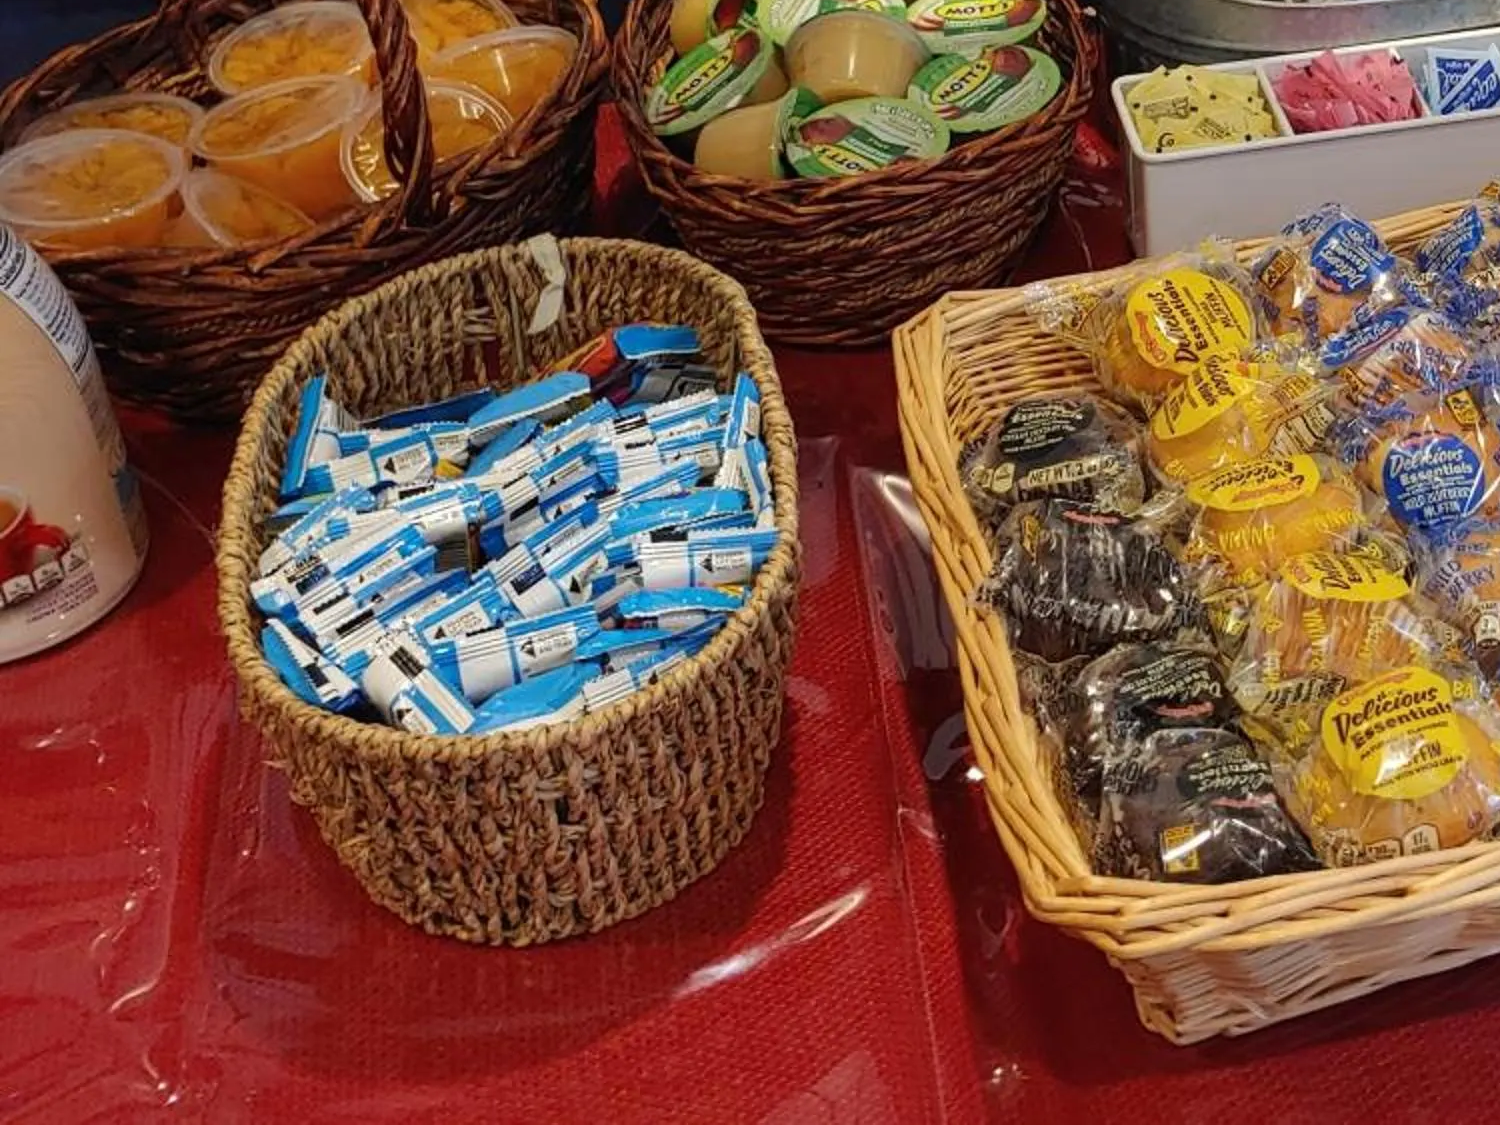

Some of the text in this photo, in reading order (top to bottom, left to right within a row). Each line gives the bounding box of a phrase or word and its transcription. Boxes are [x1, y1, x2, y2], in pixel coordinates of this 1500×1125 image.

[938, 62, 988, 101] MOTT'S
[1147, 291, 1199, 363] Delicious
[1163, 279, 1209, 351] Essentials
[1389, 448, 1465, 478] Delicious
[1399, 463, 1473, 487] Essentials
[1332, 687, 1439, 745] Delicious
[1350, 702, 1453, 750] Essentials
